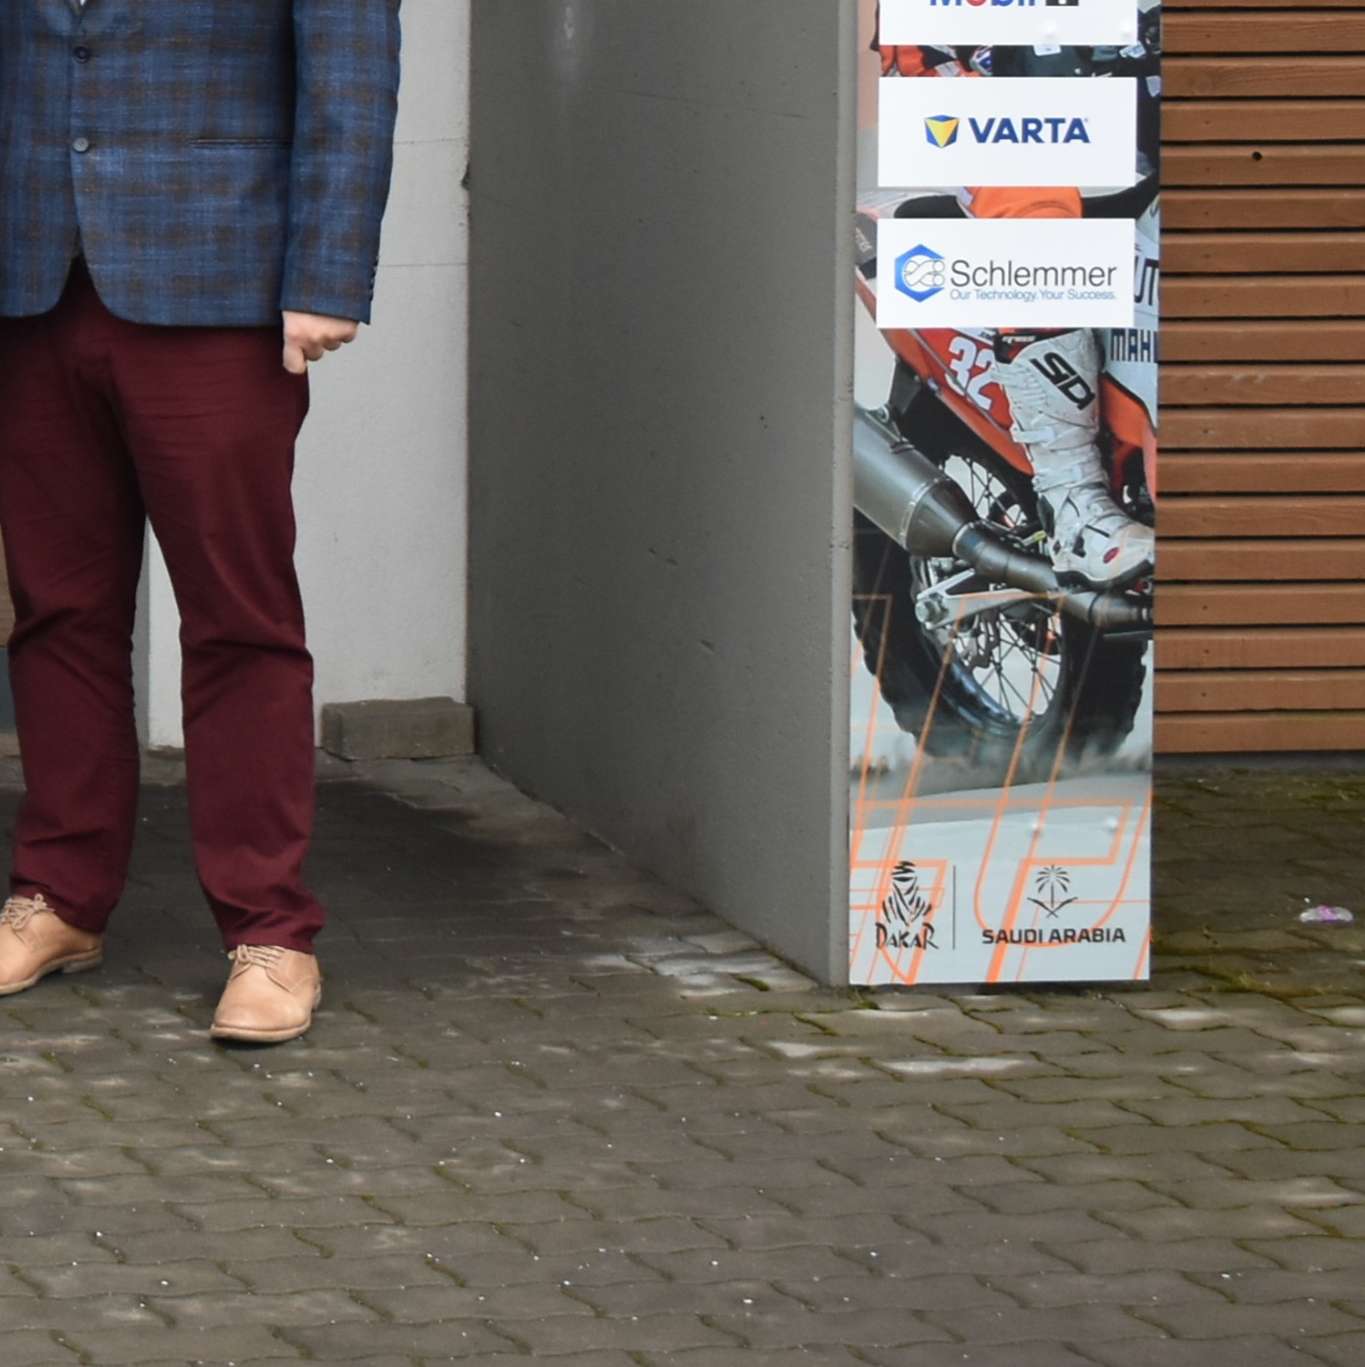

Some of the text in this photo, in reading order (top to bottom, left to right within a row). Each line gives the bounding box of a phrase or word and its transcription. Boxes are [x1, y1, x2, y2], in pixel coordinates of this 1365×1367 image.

[968, 117, 1091, 144] VARTA
[950, 260, 1117, 287] Schlemmer
[950, 289, 971, 301] Our
[1041, 289, 1064, 301] Your
[875, 922, 939, 950] DAKAR
[981, 928, 1127, 944] SAUDI ARABIA
